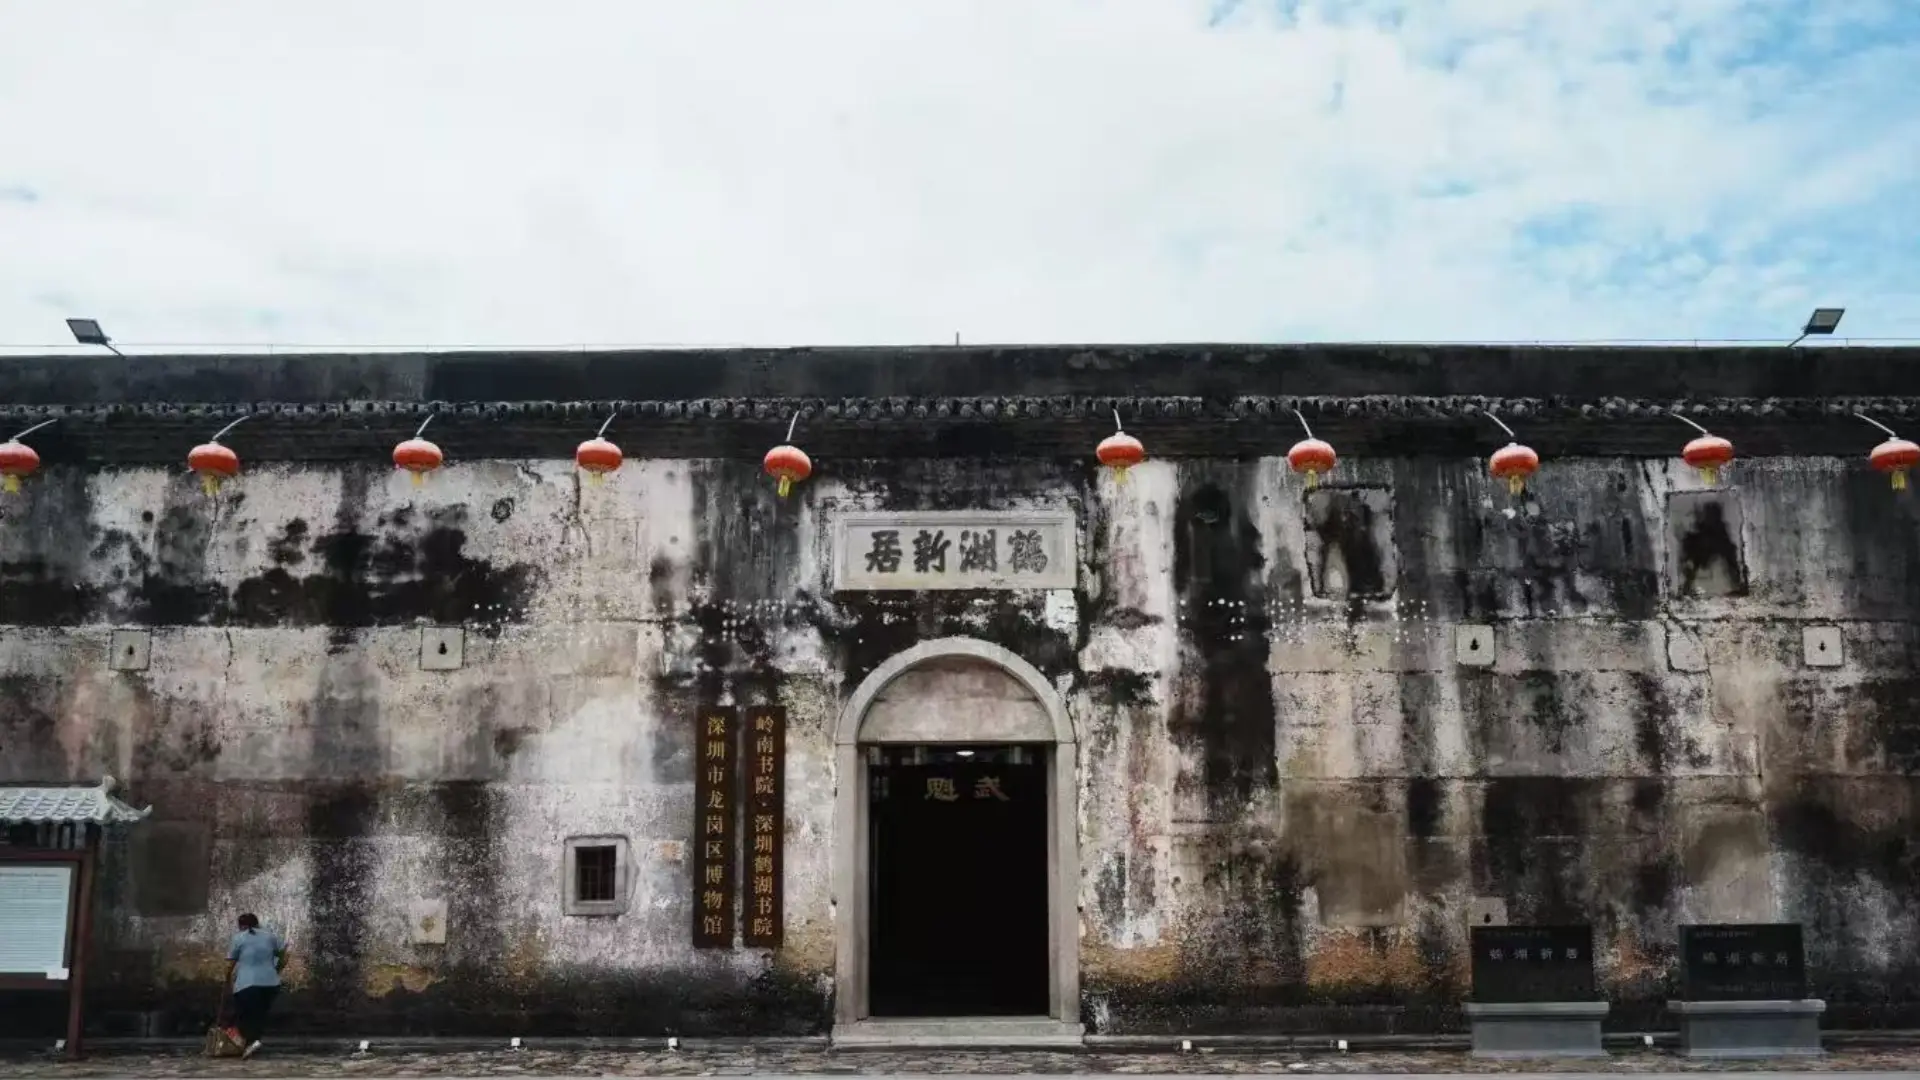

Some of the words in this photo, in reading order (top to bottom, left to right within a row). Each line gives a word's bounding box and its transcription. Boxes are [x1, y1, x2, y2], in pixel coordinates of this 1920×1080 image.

[704, 716, 726, 935] 深圳市龙岗区博物馆
